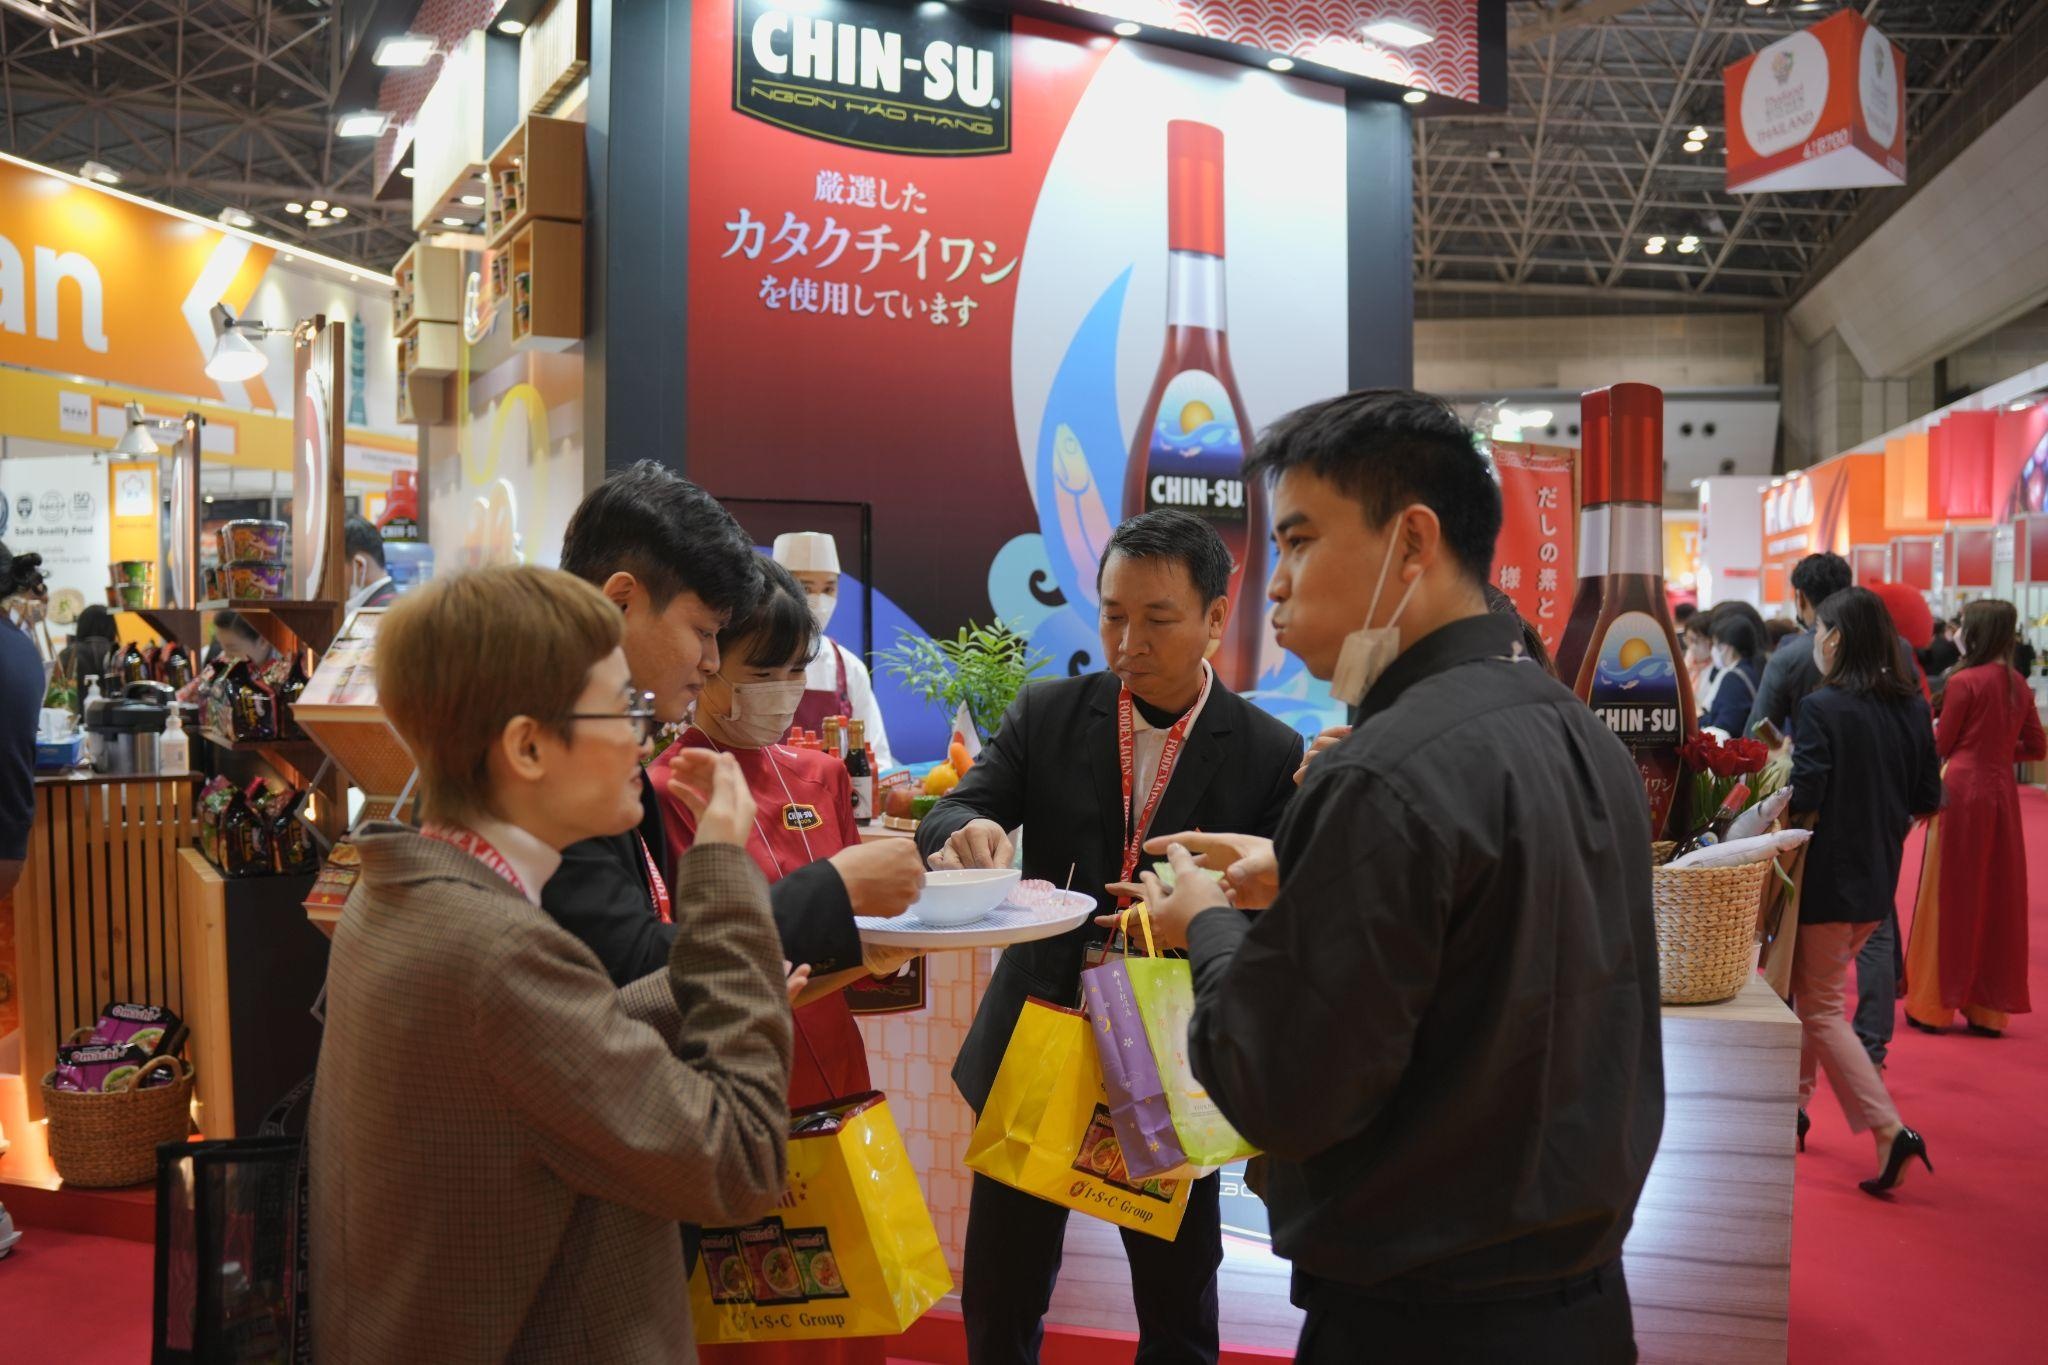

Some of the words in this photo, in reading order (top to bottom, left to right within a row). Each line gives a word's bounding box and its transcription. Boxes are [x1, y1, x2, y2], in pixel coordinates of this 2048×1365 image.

[752, 11, 994, 109] CHIN-SU
[751, 86, 837, 110] NGON
[814, 169, 928, 214] 厳選した
[720, 208, 1019, 284] カタクチイワシ
[758, 274, 978, 328] を使用しています
[1151, 475, 1244, 508] CHIN-SU
[15, 527, 34, 535] Safe
[37, 527, 69, 537] Quality
[71, 526, 93, 535] Food
[112, 1005, 153, 1021] Omachi
[71, 1049, 119, 1063] Omachi
[1120, 1200, 1153, 1223] Group
[799, 1312, 845, 1328] Group
